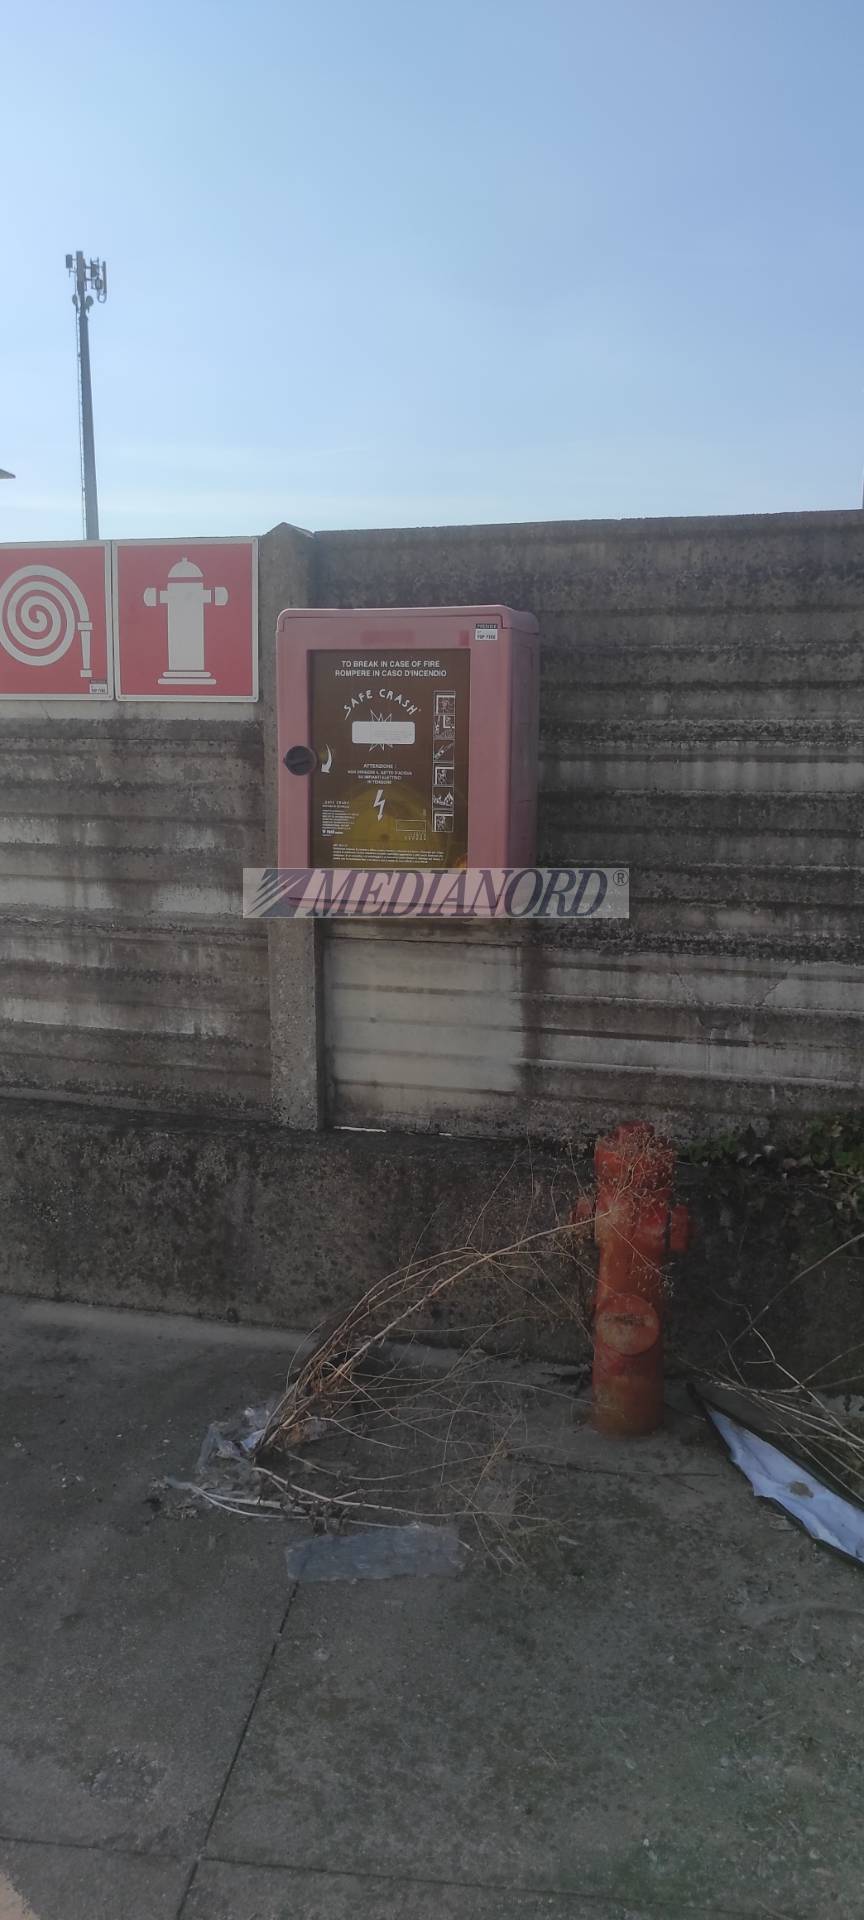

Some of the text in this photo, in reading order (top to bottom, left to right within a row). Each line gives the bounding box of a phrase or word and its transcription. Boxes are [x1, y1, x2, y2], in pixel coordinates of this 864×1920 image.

[341, 660, 440, 668] TO BREAK IN CASE OF FIRE
[335, 669, 447, 677] ROMPERE IN CASO D'INCENDIO
[343, 688, 418, 721] SAFE CRASH
